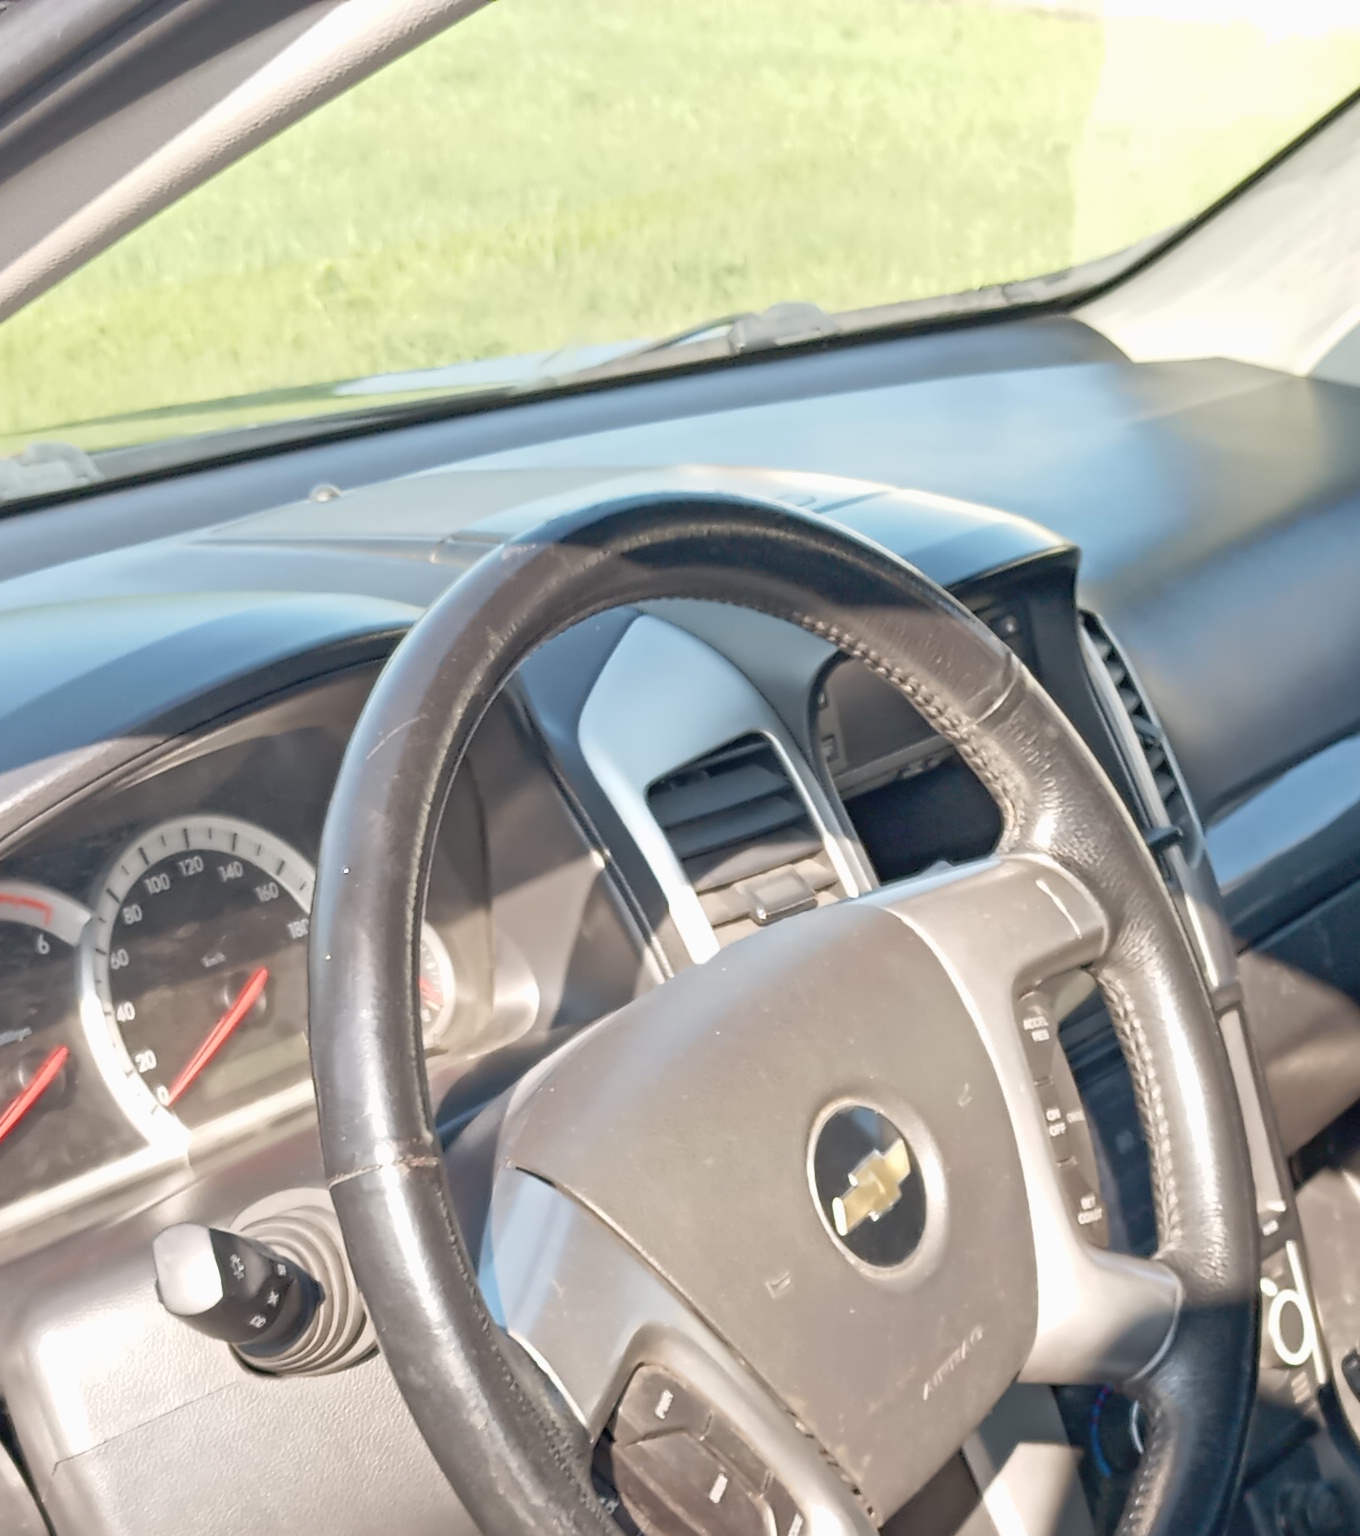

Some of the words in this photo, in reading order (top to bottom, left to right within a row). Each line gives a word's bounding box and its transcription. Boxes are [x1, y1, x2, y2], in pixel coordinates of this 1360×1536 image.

[178, 855, 205, 877] 120
[217, 860, 244, 882] 140
[143, 873, 171, 895] 100
[255, 882, 279, 903] 160
[122, 904, 143, 926] 80
[37, 934, 51, 955] 6
[110, 948, 130, 970] 60
[116, 1001, 136, 1023] 40
[135, 1049, 157, 1073] 20
[156, 1085, 169, 1106] 0
